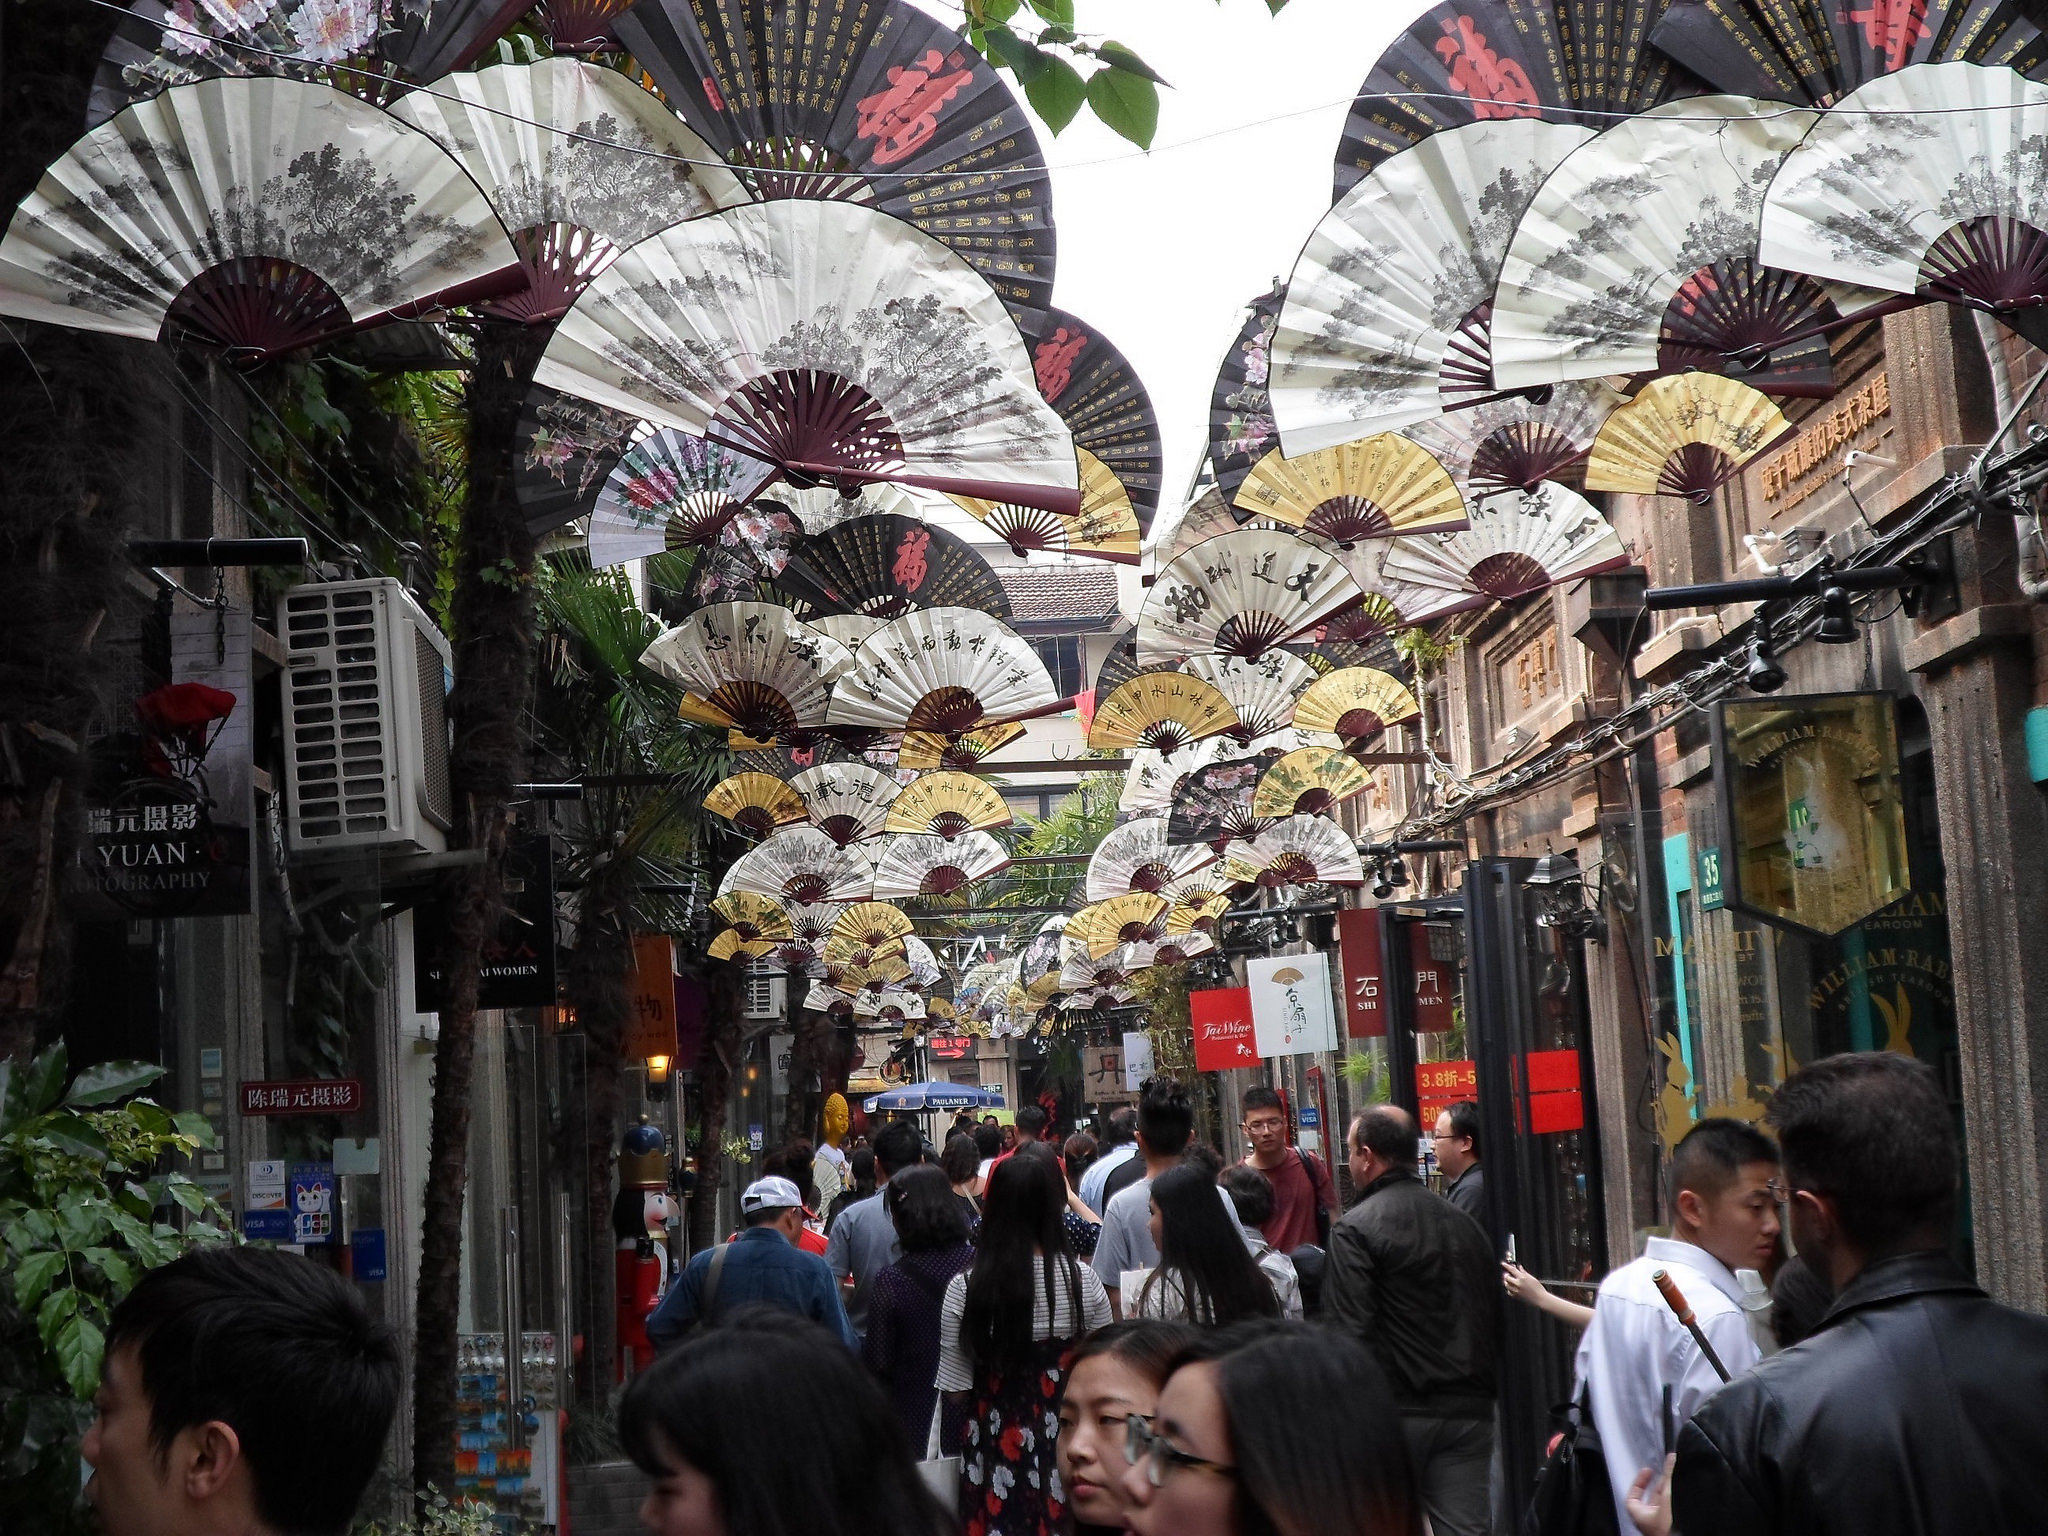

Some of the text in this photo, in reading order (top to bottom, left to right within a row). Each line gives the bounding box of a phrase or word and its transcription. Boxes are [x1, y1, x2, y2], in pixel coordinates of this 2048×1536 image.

[98, 842, 187, 868] YUAN
[1704, 854, 1719, 887] 35
[1862, 919, 1923, 930] EAROOM
[492, 965, 538, 977] WOMEN
[1356, 971, 1439, 997] 石 門
[1358, 997, 1443, 1011] SHI MEN
[246, 1086, 352, 1109] 陈瑞元摄影
[932, 1097, 969, 1106] PAULANER
[252, 1192, 282, 1200] DISCOVER
[245, 1220, 265, 1229] VISA
[302, 1219, 329, 1229] JCB
